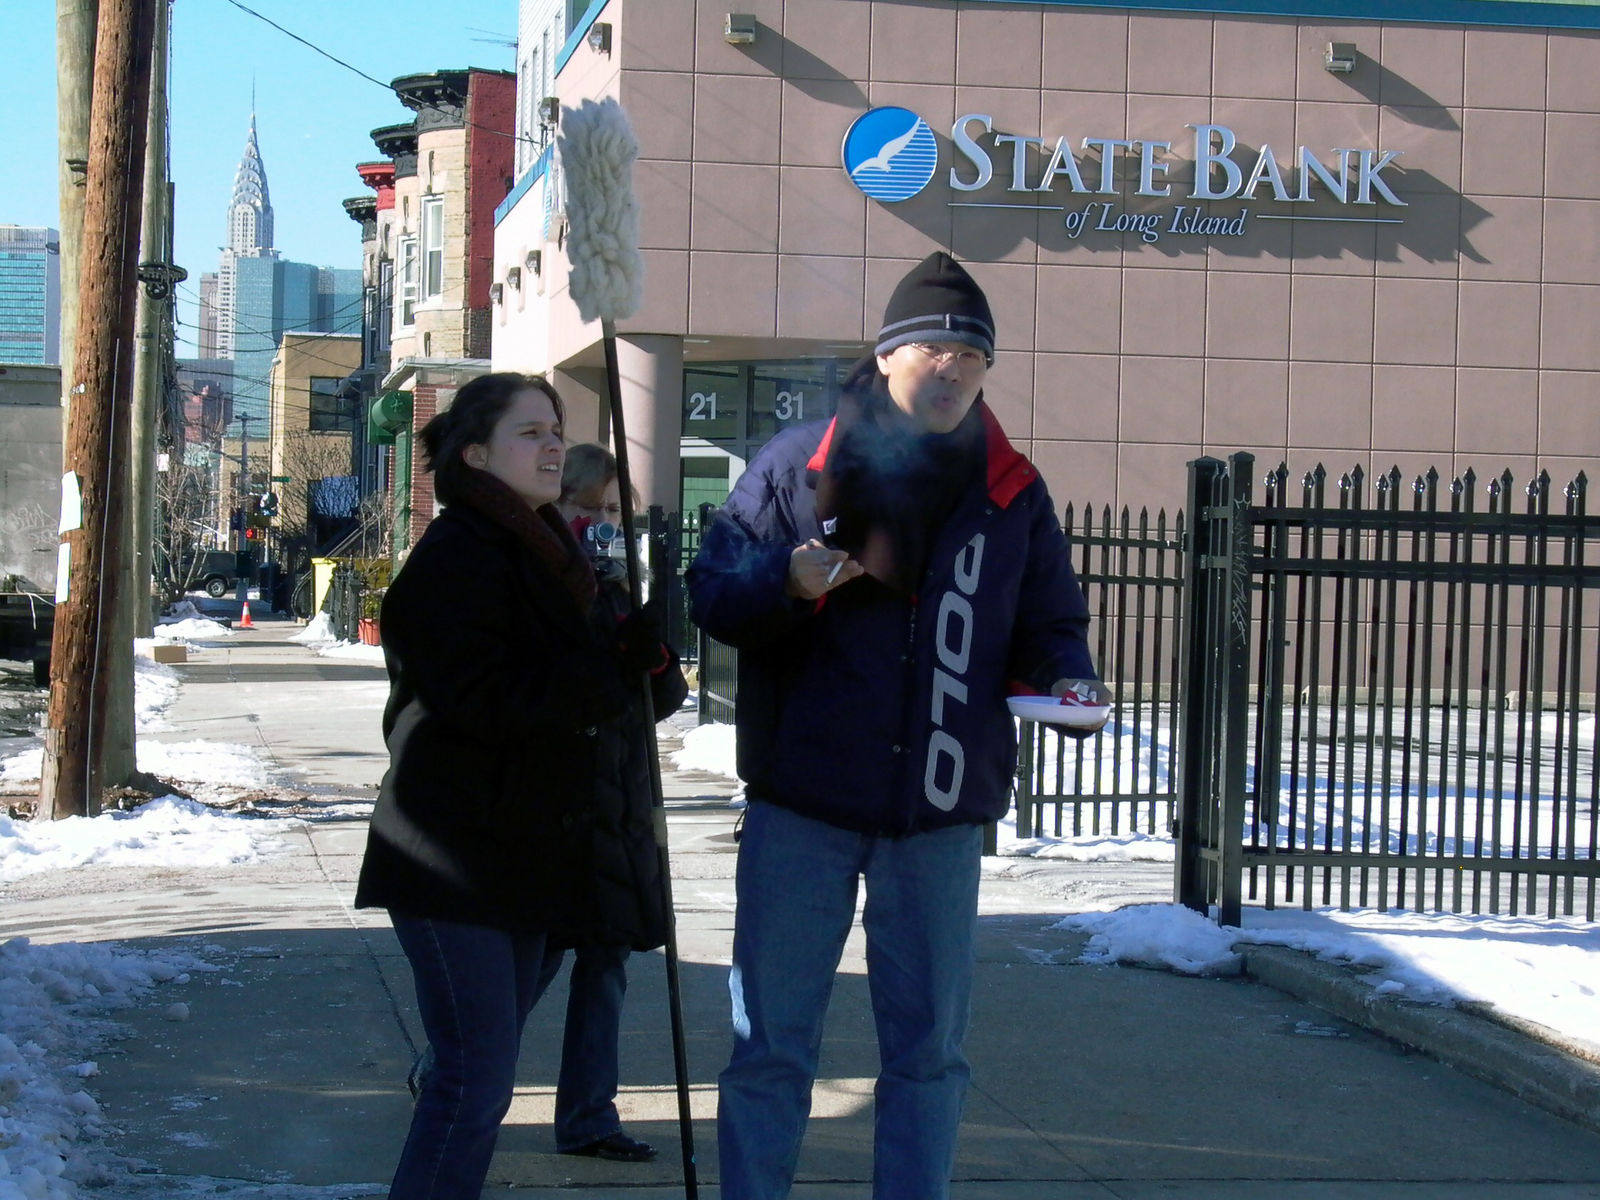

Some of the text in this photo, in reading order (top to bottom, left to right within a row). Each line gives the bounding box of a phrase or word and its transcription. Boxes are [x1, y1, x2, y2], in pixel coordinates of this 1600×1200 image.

[949, 113, 1409, 206] STATE BANK
[1065, 201, 1248, 243] of Long Island
[689, 392, 717, 420] 21
[775, 391, 804, 420] 31
[925, 532, 985, 812] POLO
